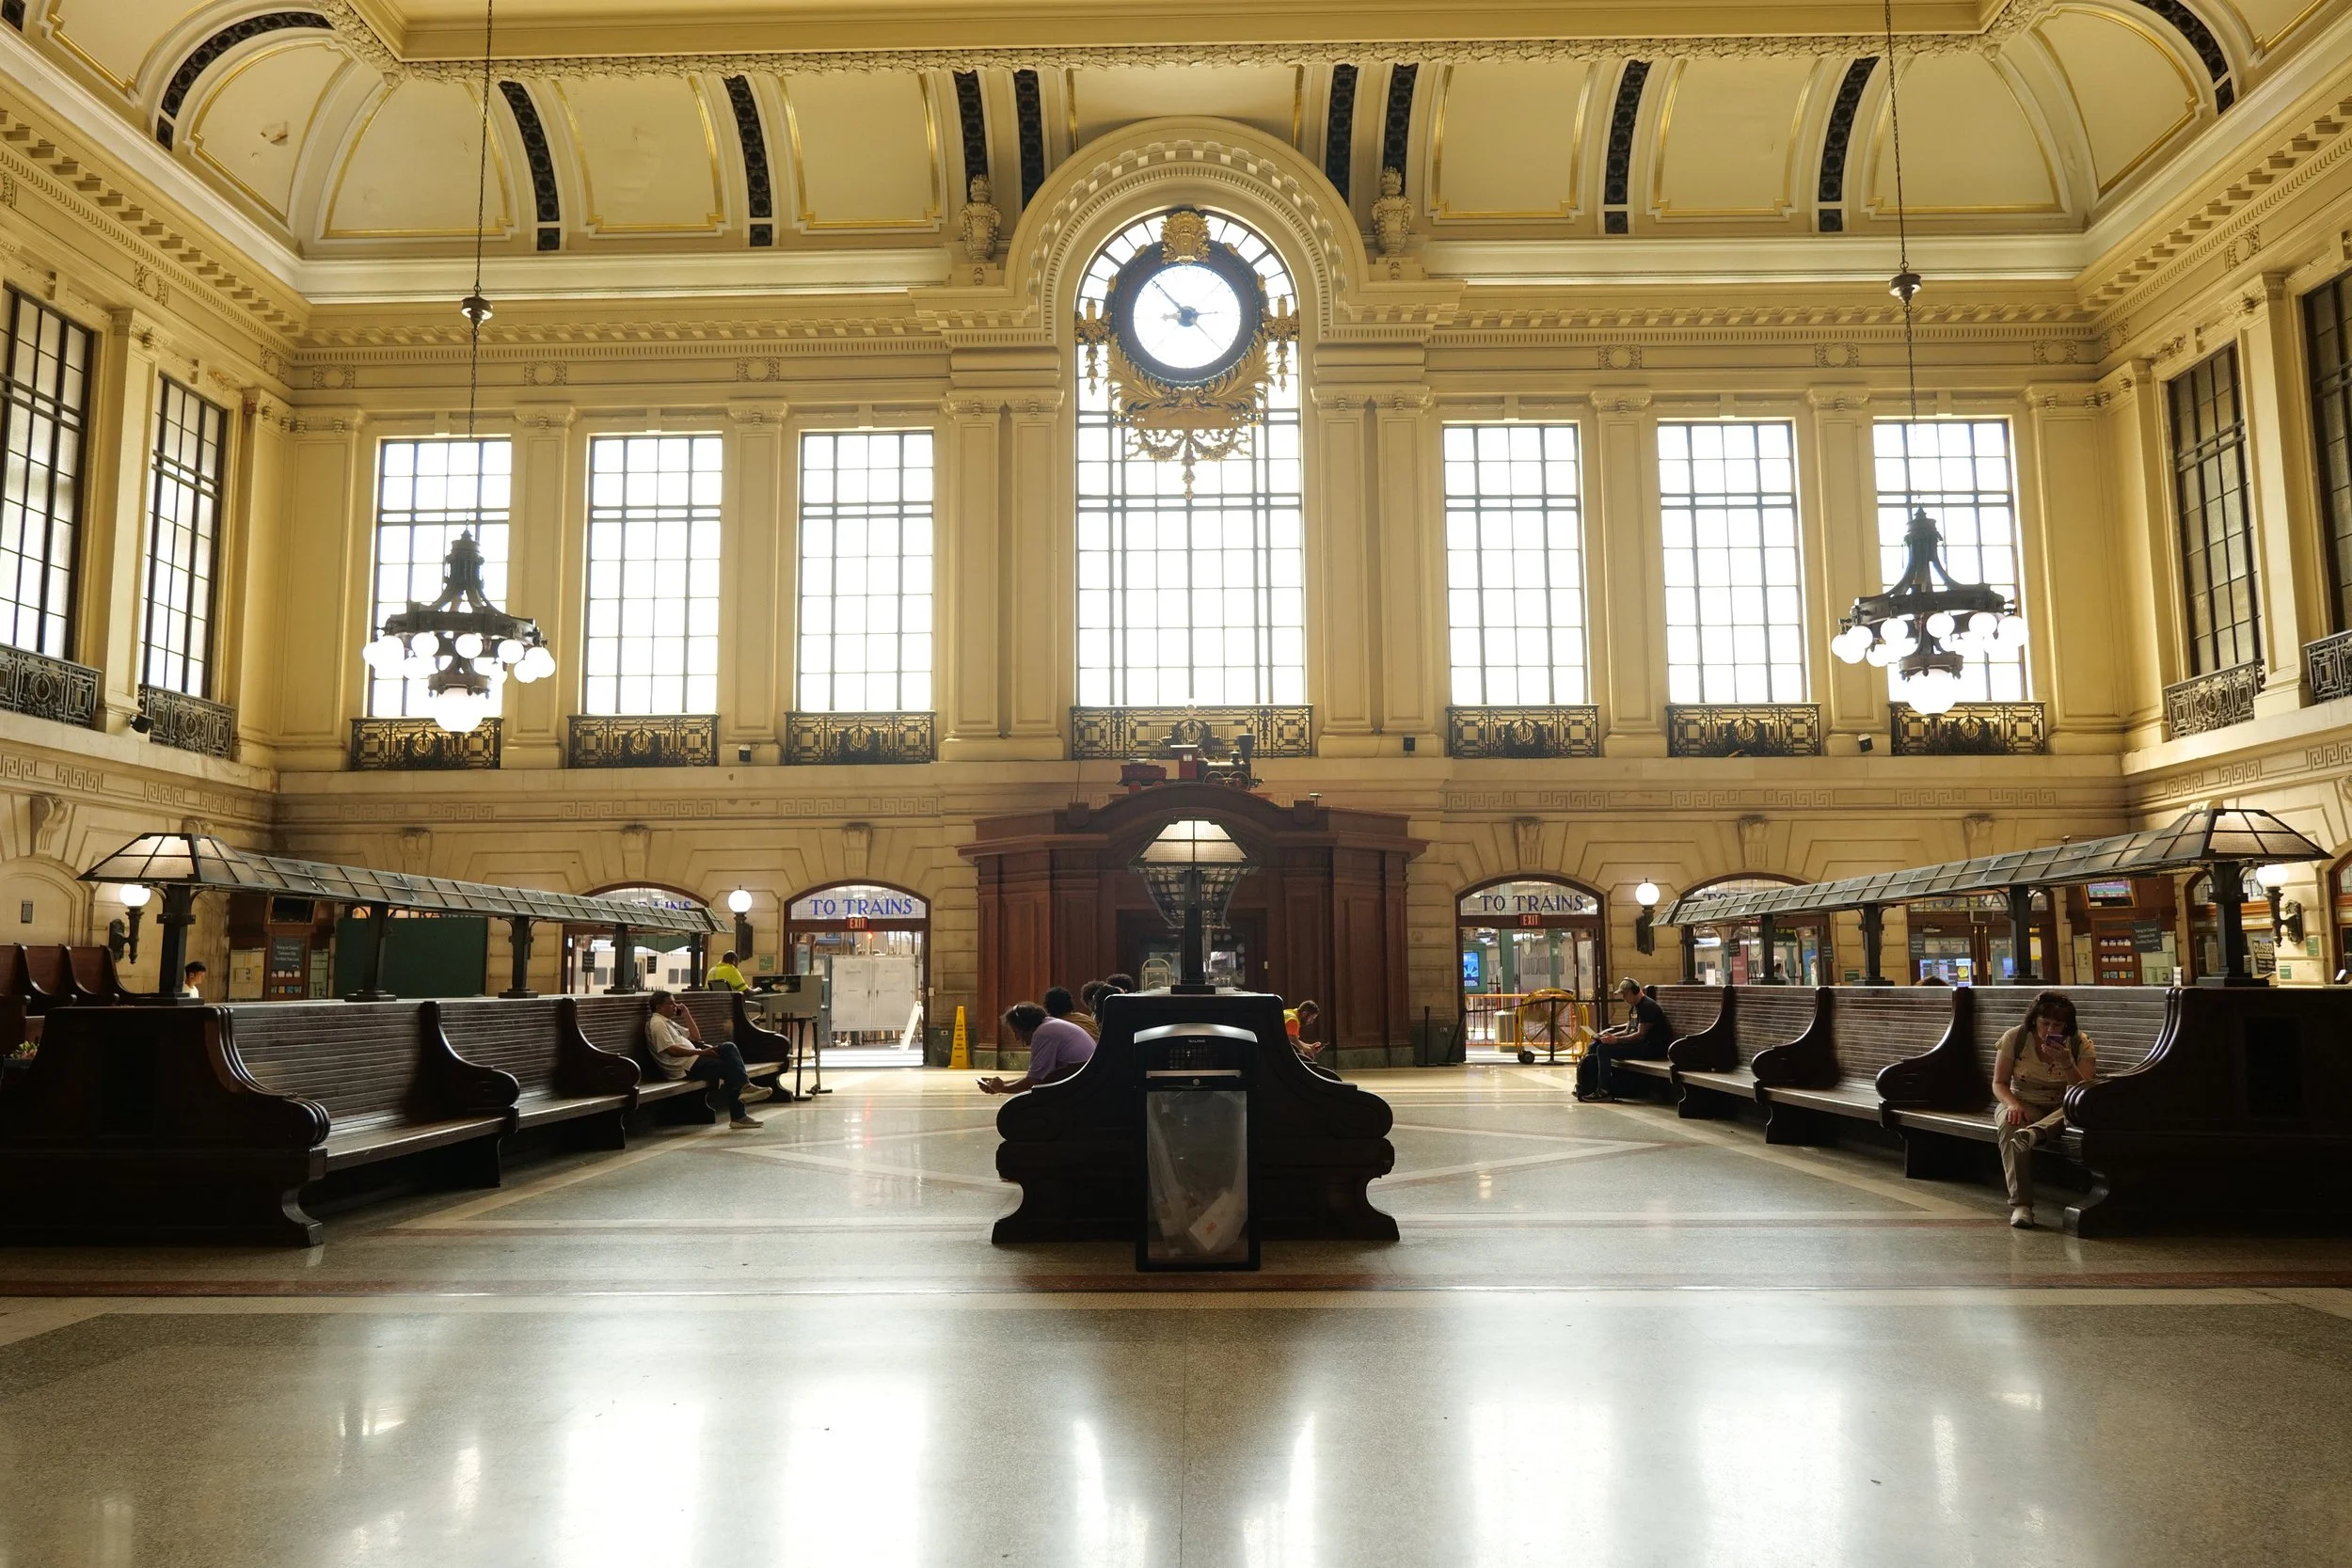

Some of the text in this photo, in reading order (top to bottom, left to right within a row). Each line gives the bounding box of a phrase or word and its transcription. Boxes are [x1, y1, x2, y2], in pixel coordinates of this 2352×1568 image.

[809, 898, 913, 915] TO TRAINS
[1479, 895, 1583, 911] TO TRAINS
[850, 918, 866, 929] EXIT
[1523, 914, 1539, 927] EXIT
[2253, 942, 2274, 954] CLOSED
